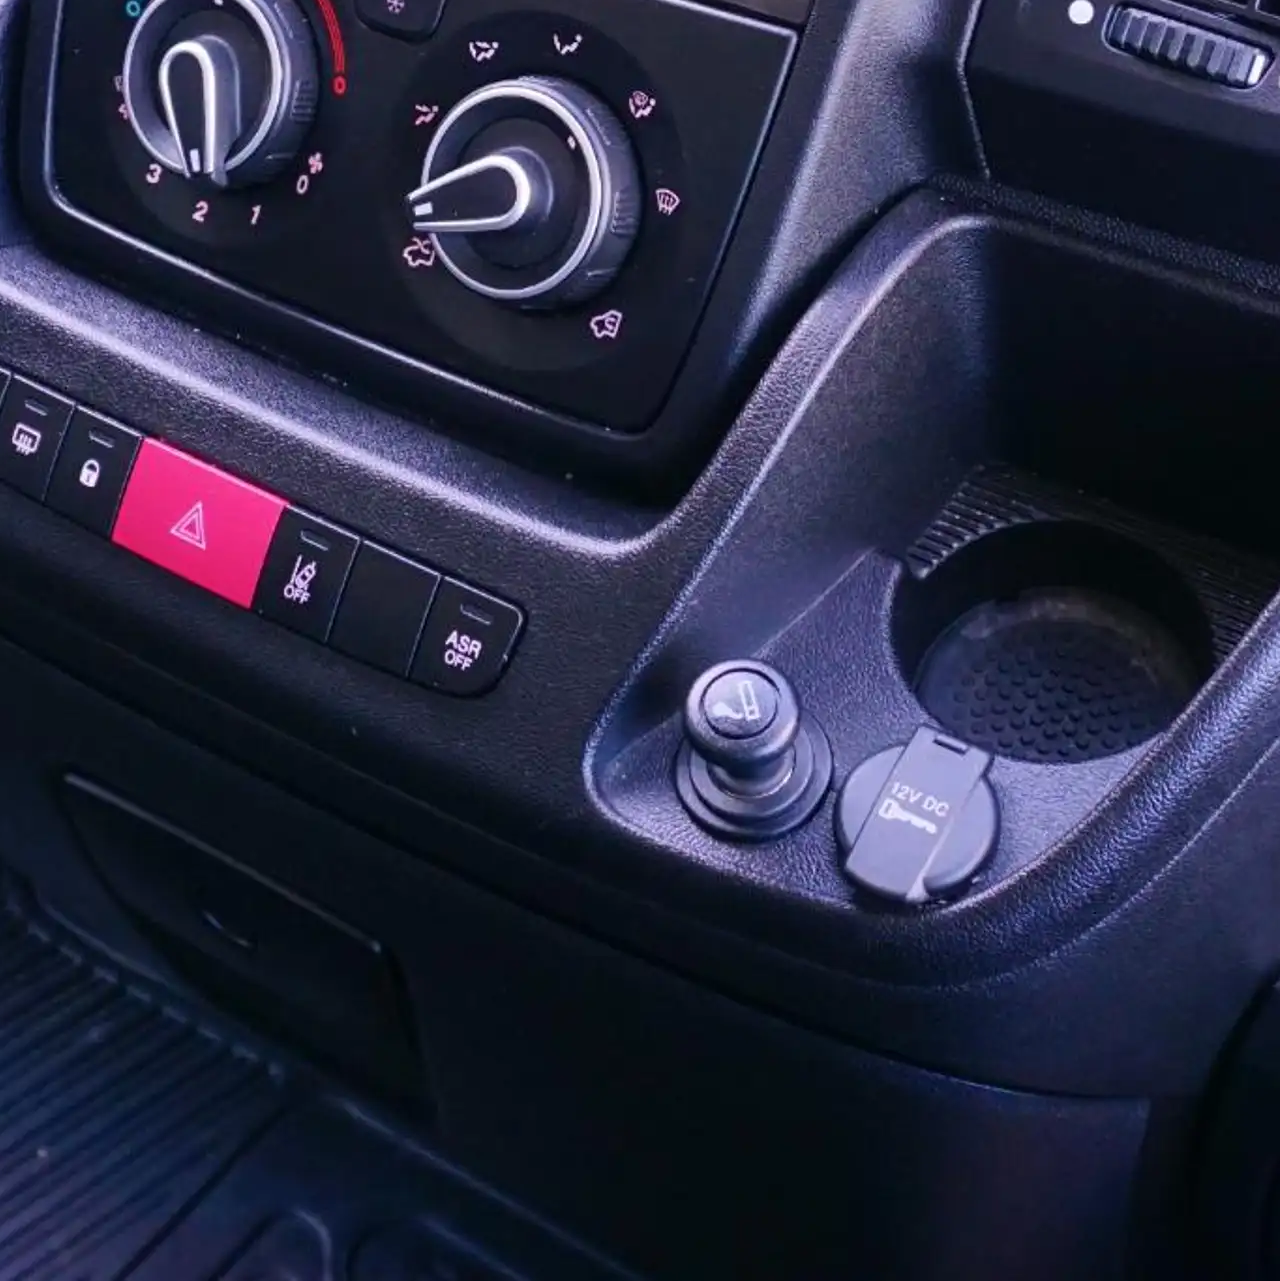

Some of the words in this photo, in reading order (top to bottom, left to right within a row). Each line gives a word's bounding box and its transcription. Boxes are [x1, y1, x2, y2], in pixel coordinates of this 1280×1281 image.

[146, 164, 161, 183] 3
[296, 174, 310, 195] 0
[192, 200, 209, 222] 2
[251, 205, 261, 224] 1
[283, 584, 312, 604] OFF
[444, 629, 483, 660] ASR
[443, 649, 474, 671] OFF
[891, 782, 923, 803] 12V
[922, 795, 950, 817] DC
